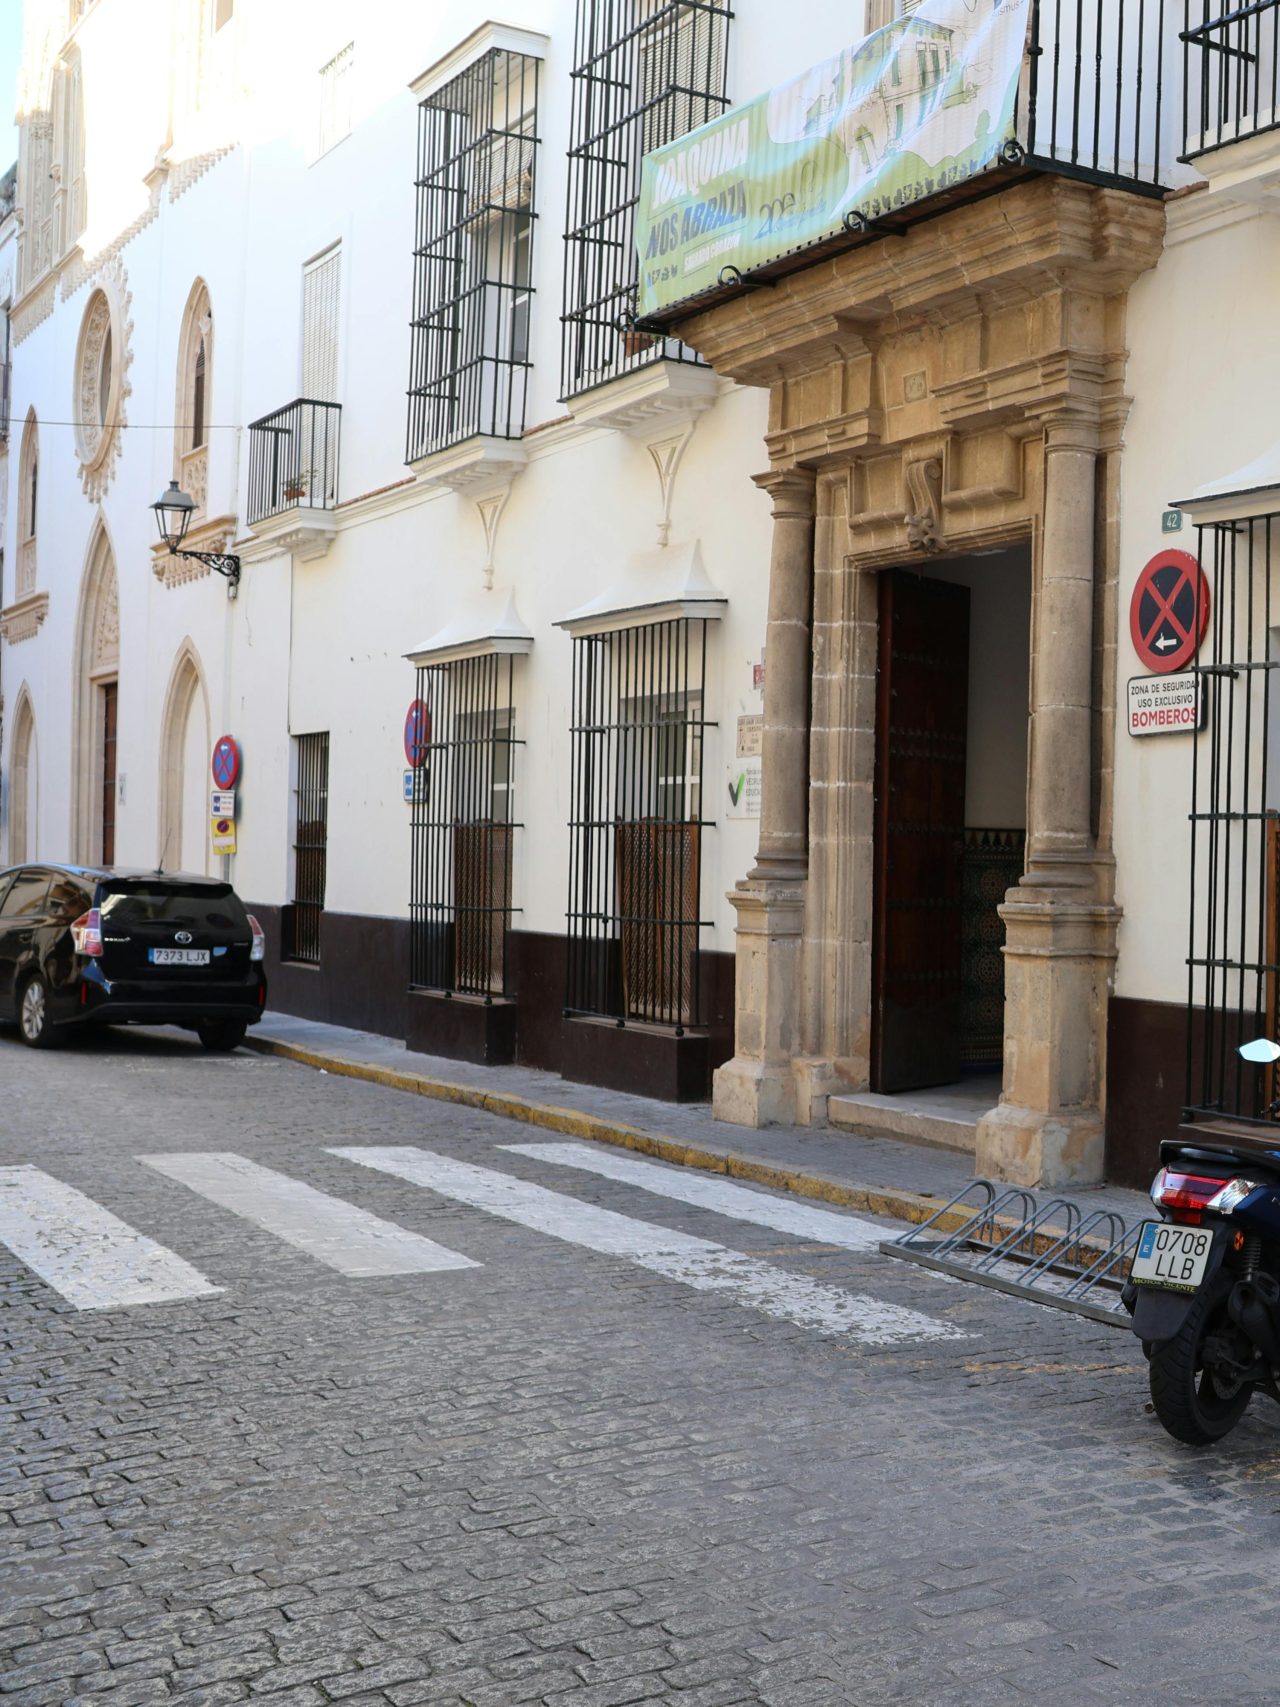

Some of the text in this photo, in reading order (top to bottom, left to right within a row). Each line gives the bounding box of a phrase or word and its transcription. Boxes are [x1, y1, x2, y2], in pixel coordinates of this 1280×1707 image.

[652, 117, 750, 211] JOAQUINA
[645, 213, 678, 260] NOS
[680, 180, 747, 245] ABRAZA
[1166, 513, 1177, 528] 42
[1131, 685, 1149, 696] ZONA
[1152, 683, 1160, 693] DE
[1138, 694, 1193, 708] USO EXCLUSIVO
[1132, 707, 1197, 728] BOMBEROS
[155, 949, 183, 961] 7373
[186, 951, 207, 962] LJX
[1143, 1244, 1149, 1253] E
[1156, 1229, 1208, 1257] 0708
[1155, 1254, 1195, 1280] LLB
[1163, 1281, 1197, 1293] VICENTE
